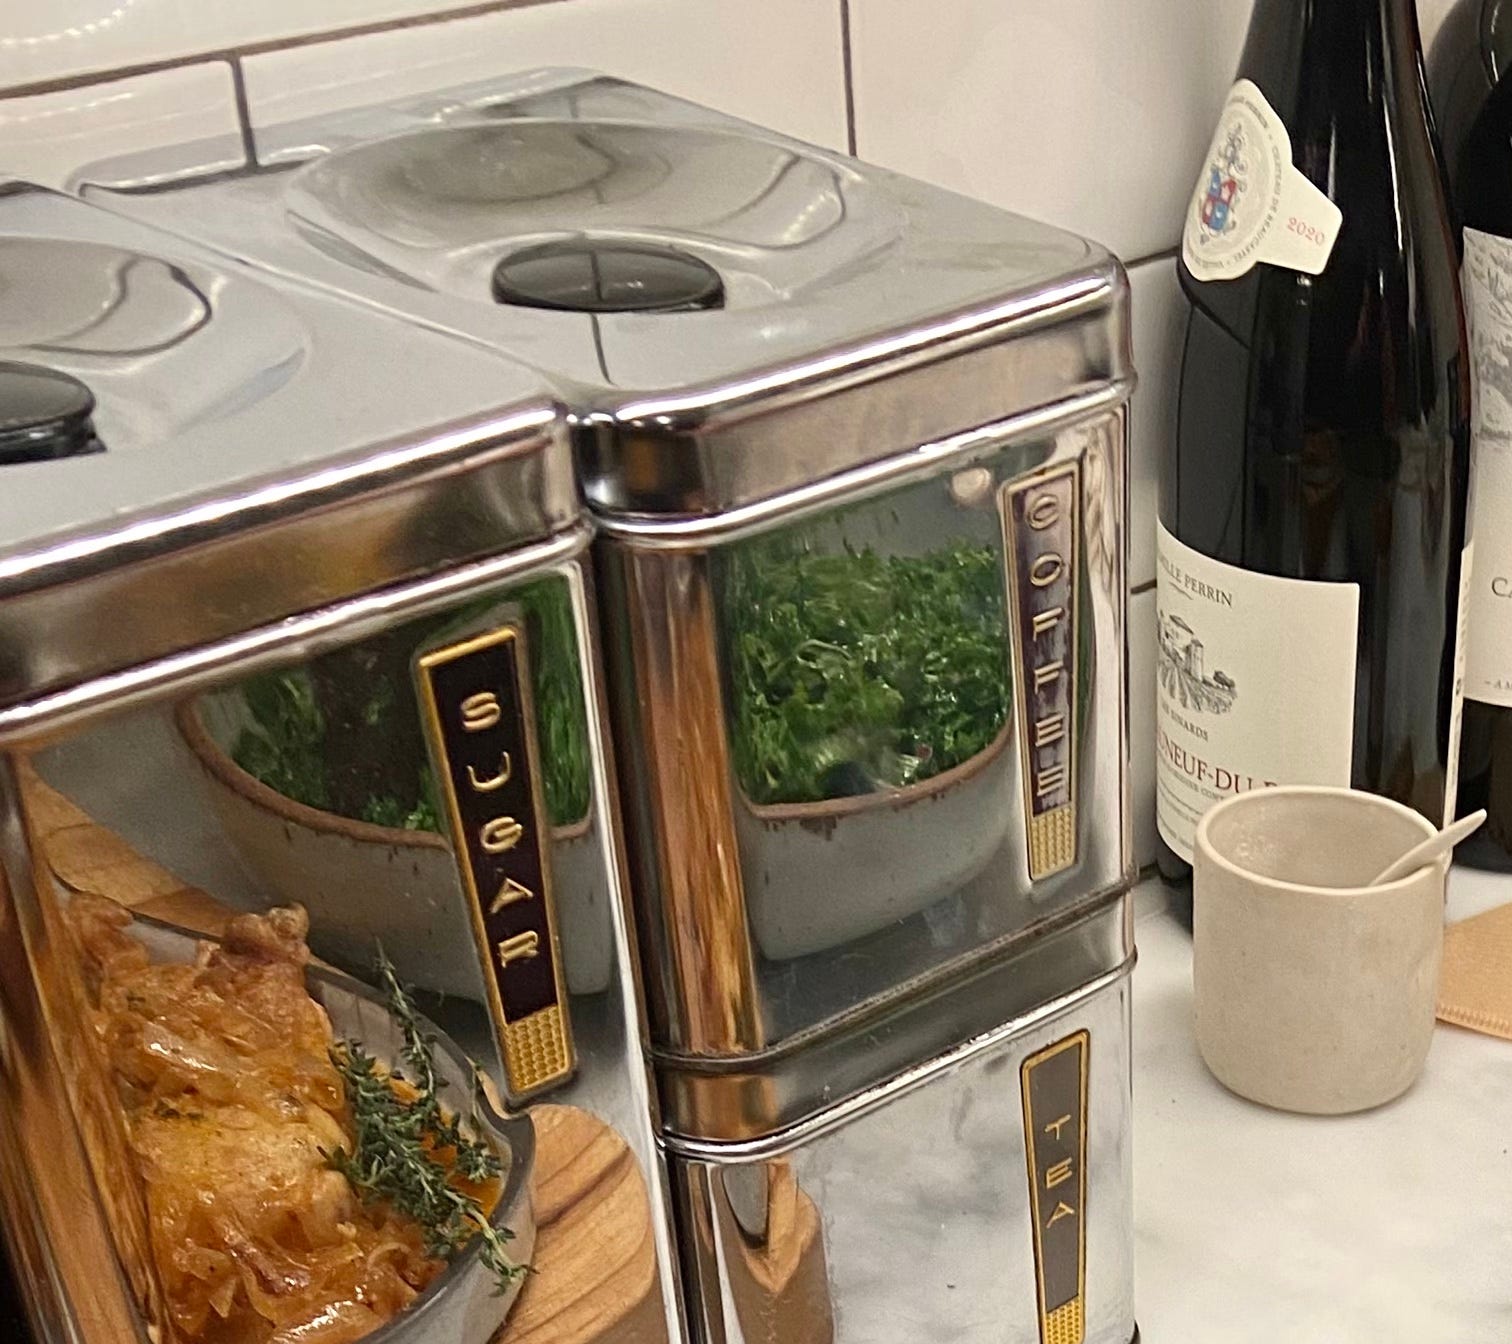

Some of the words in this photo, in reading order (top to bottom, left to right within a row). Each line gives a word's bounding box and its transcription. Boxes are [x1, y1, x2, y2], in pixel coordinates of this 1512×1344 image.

[1287, 216, 1326, 246] 2020
[1025, 492, 1066, 797] COFFEE
[1184, 573, 1233, 607] PERRIN
[460, 690, 541, 969] SUGAR
[1043, 1113, 1076, 1229] TEA
